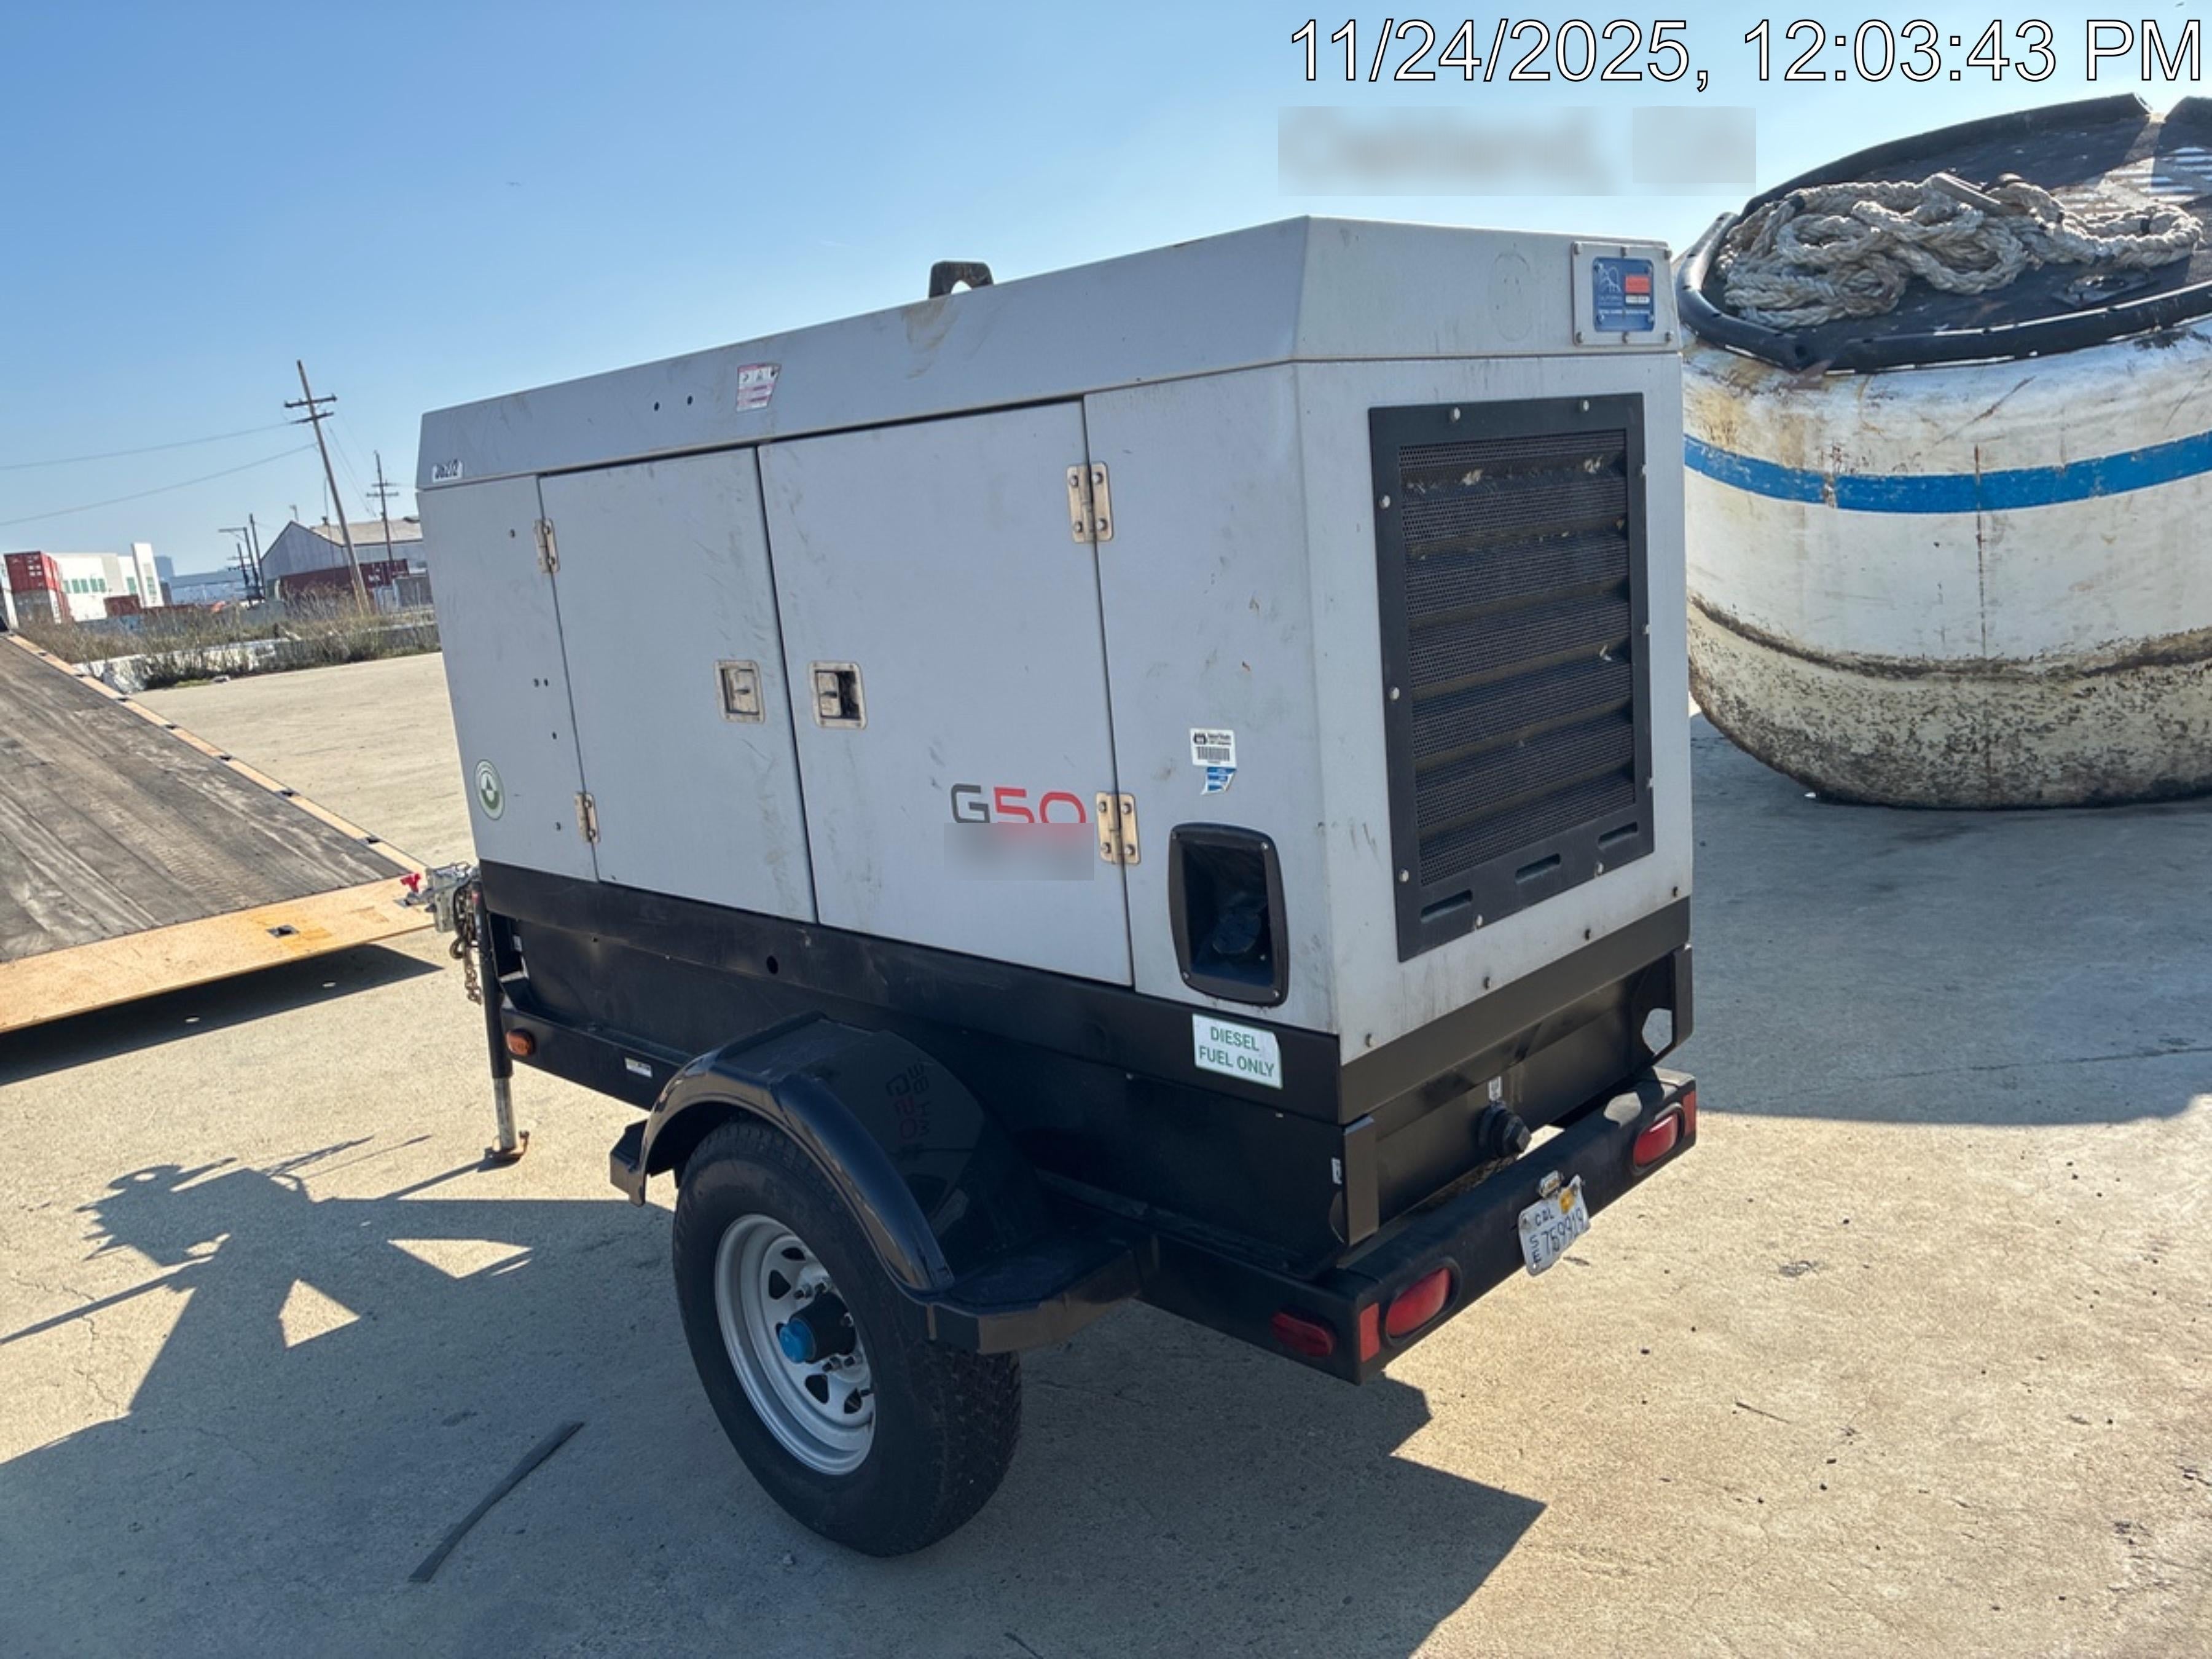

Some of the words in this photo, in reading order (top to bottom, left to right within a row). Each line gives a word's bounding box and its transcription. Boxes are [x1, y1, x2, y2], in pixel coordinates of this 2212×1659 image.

[951, 783, 1087, 825] G50
[1210, 1026, 1260, 1051] DIESEL
[1199, 1045, 1234, 1067] FUEL
[1236, 1055, 1274, 1077] ONLY
